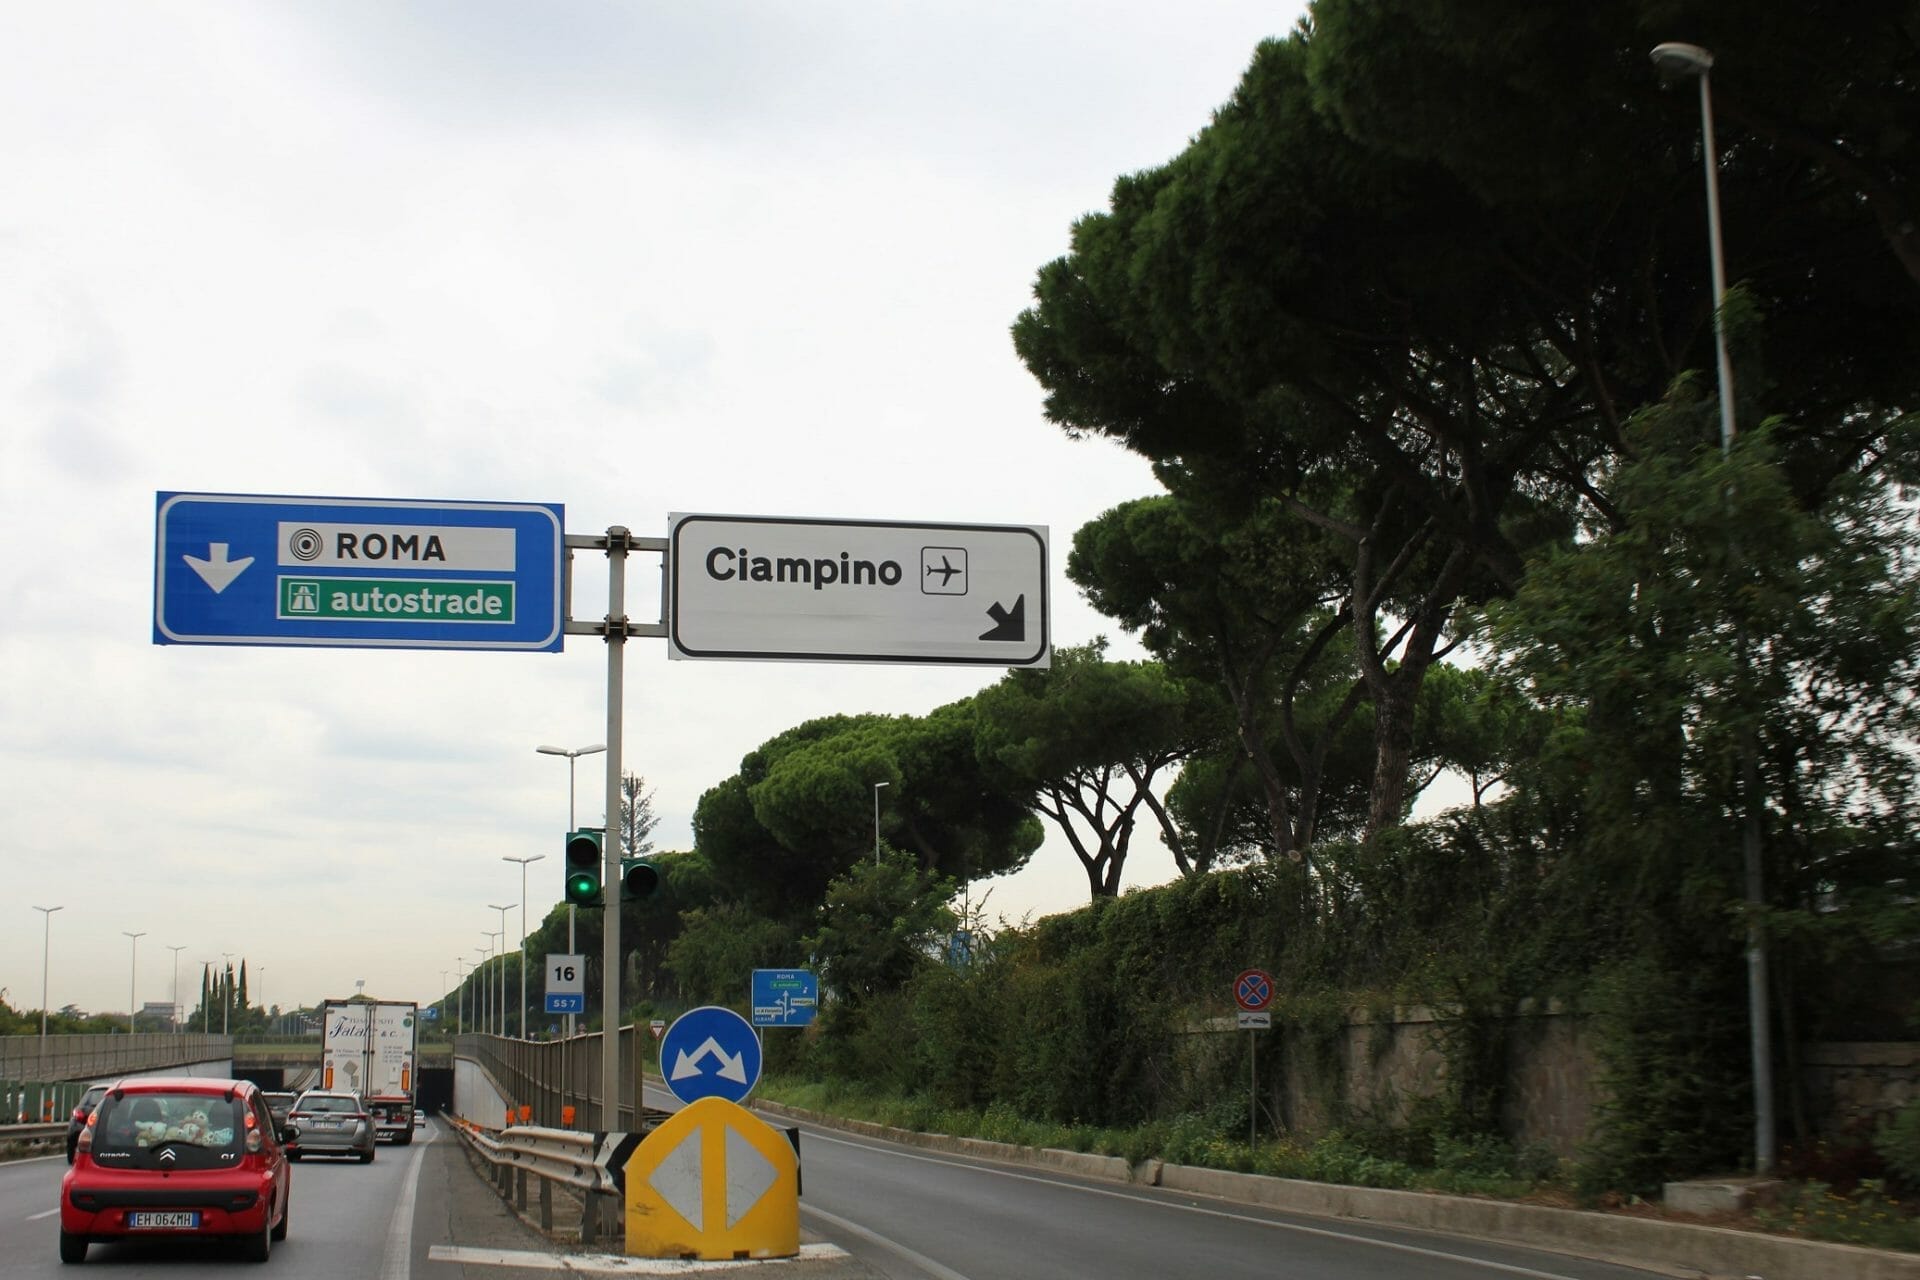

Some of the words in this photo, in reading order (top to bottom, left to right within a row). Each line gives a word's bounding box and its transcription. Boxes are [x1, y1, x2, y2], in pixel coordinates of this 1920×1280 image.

[336, 532, 446, 562] ROMA
[706, 546, 903, 590] Ciampino
[331, 587, 503, 615] autostrade
[554, 966, 575, 982] 16
[553, 1000, 567, 1008] SS
[570, 1000, 576, 1008] 7
[136, 1213, 151, 1225] EH
[155, 1213, 191, 1226] 064MH
